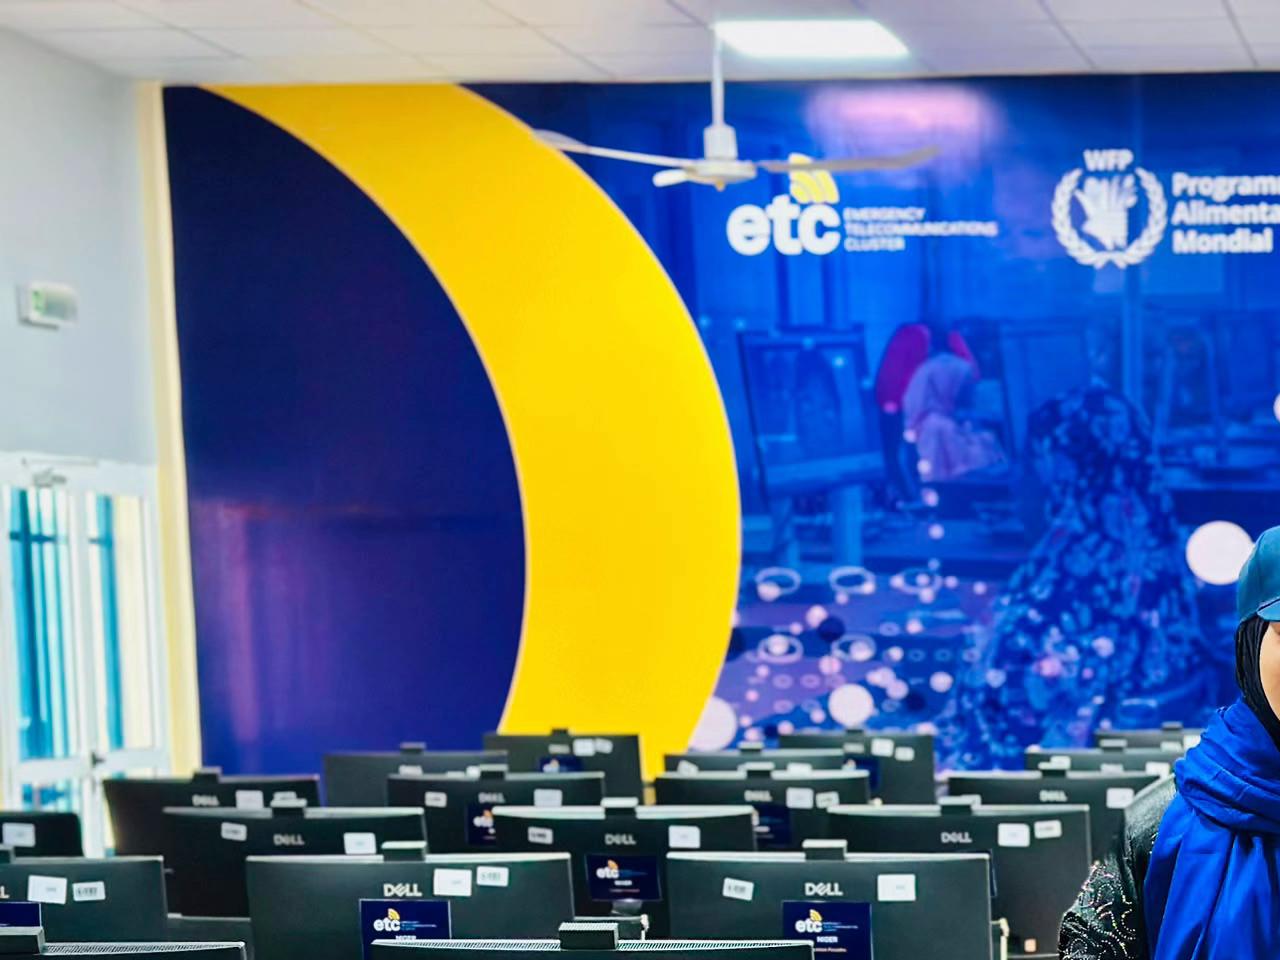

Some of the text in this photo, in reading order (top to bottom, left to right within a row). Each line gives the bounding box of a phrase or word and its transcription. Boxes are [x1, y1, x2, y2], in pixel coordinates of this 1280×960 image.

[1083, 149, 1134, 171] WFP
[843, 207, 925, 220] EMERGENCY
[726, 194, 841, 256] etc
[844, 221, 998, 237] TELECOMMUNICATIONS
[843, 237, 906, 252] CLUSTER
[1172, 227, 1273, 253] Mondial
[604, 834, 636, 845] DELL
[383, 883, 422, 897] DELL
[804, 882, 843, 896] DELL
[373, 917, 400, 931] etc
[795, 918, 822, 933] etc
